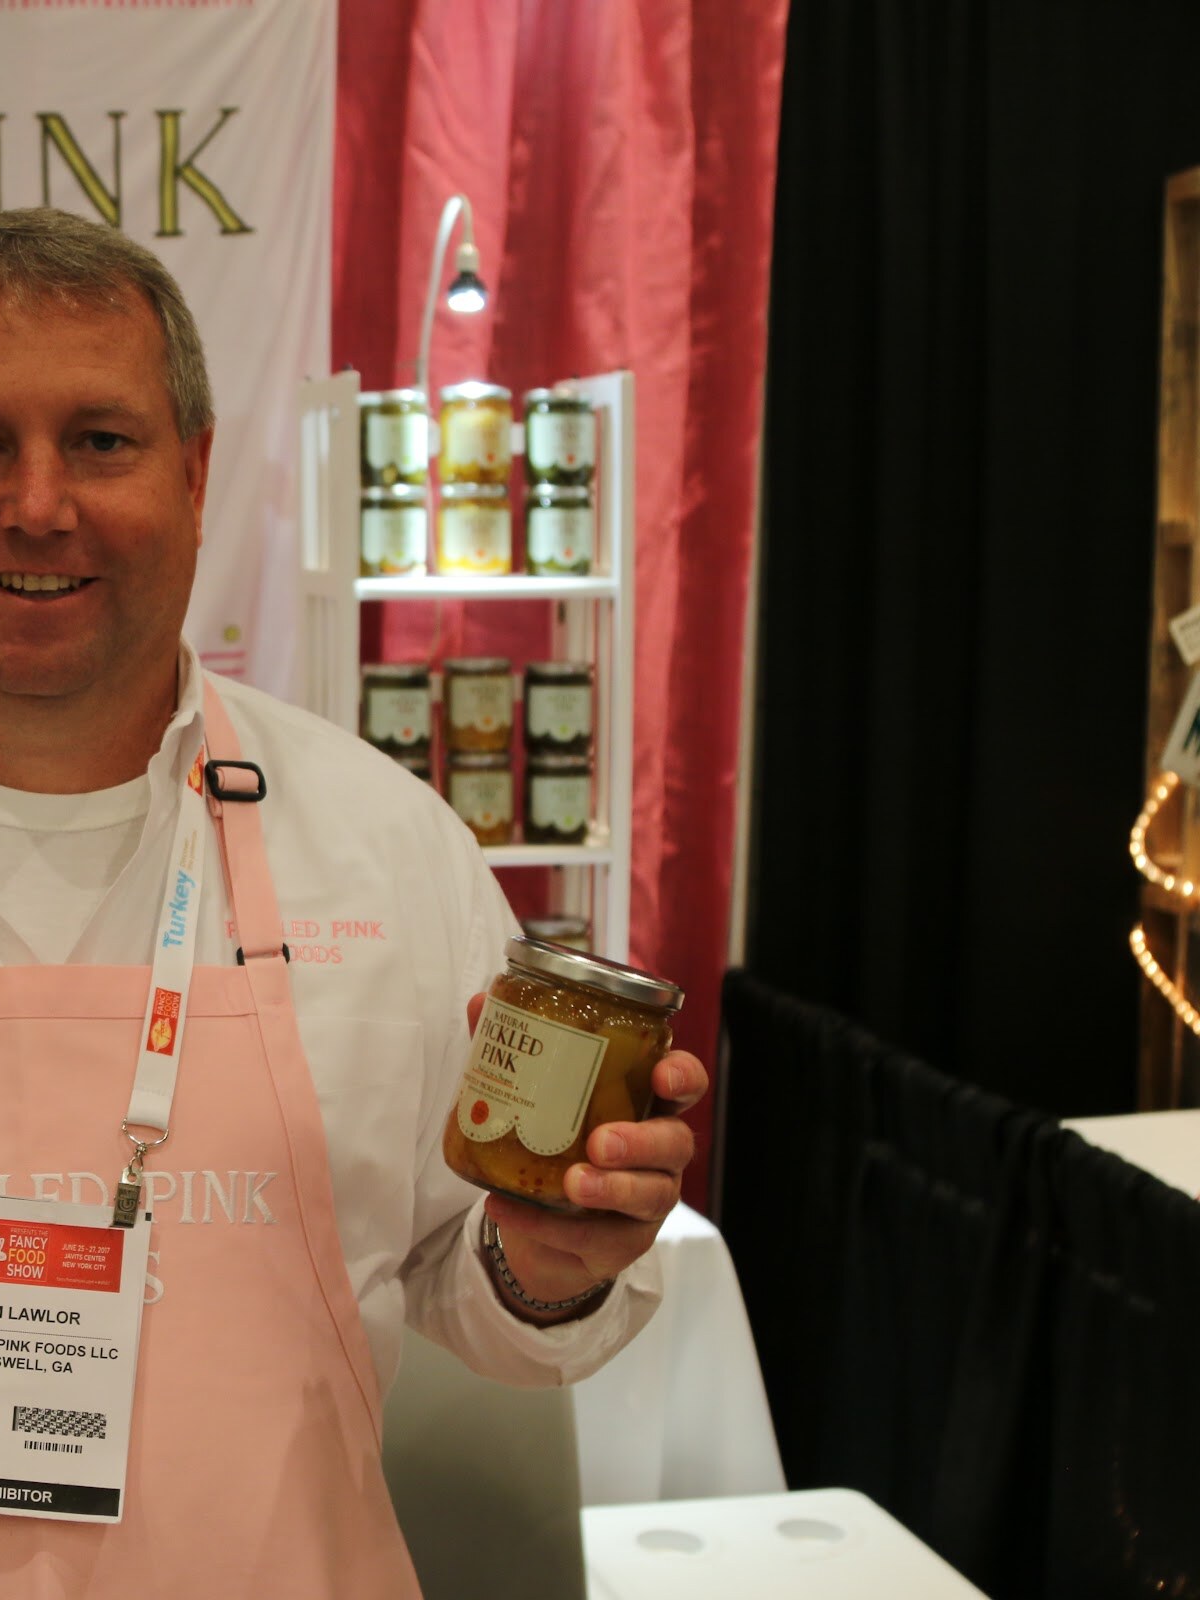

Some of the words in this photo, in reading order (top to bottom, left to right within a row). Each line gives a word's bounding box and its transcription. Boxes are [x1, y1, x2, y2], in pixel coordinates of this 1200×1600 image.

[162, 870, 196, 948] Turkey
[331, 920, 386, 940] PINK
[156, 990, 166, 1016] FANCY
[163, 992, 173, 1017] FOOD
[170, 994, 180, 1019] SHOW
[495, 1010, 529, 1033] NATURAL
[480, 1017, 543, 1057] PICKLED
[481, 1041, 519, 1073] PINK
[141, 1170, 279, 1224] PINK
[9, 1234, 48, 1250] FANCY
[62, 1243, 77, 1252] JUNE
[77, 1244, 85, 1252] 25
[98, 1246, 111, 1254] 2017
[8, 1248, 46, 1265] FOOD
[64, 1252, 83, 1261] JAVITS
[83, 1254, 106, 1262] CENTER
[77, 1262, 92, 1270] YORK
[6, 1263, 44, 1279] SHOW
[8, 1306, 81, 1325] LAWLOR
[35, 1342, 86, 1357] FOODS
[90, 1347, 119, 1360] LLC
[52, 1361, 73, 1374] GA
